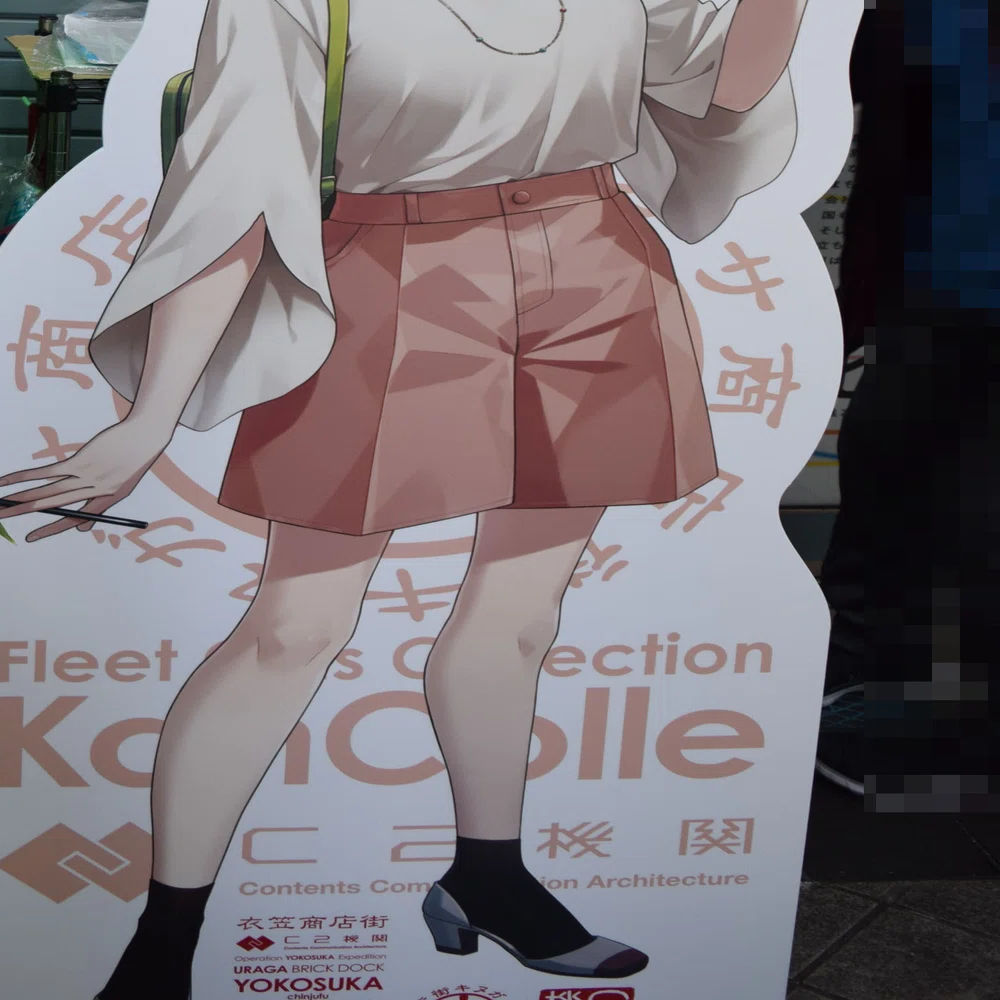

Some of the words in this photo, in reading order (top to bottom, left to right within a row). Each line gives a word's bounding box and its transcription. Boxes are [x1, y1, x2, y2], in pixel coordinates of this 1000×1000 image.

[238, 880, 361, 896] Contents
[585, 871, 750, 889] Architecture
[236, 915, 389, 930] 衣笠商店街
[338, 953, 387, 961] Expedition
[233, 965, 288, 975] URAGA
[291, 964, 335, 973] BRICK
[337, 963, 385, 973] DOCK
[233, 976, 384, 993] YOKOSUKA
